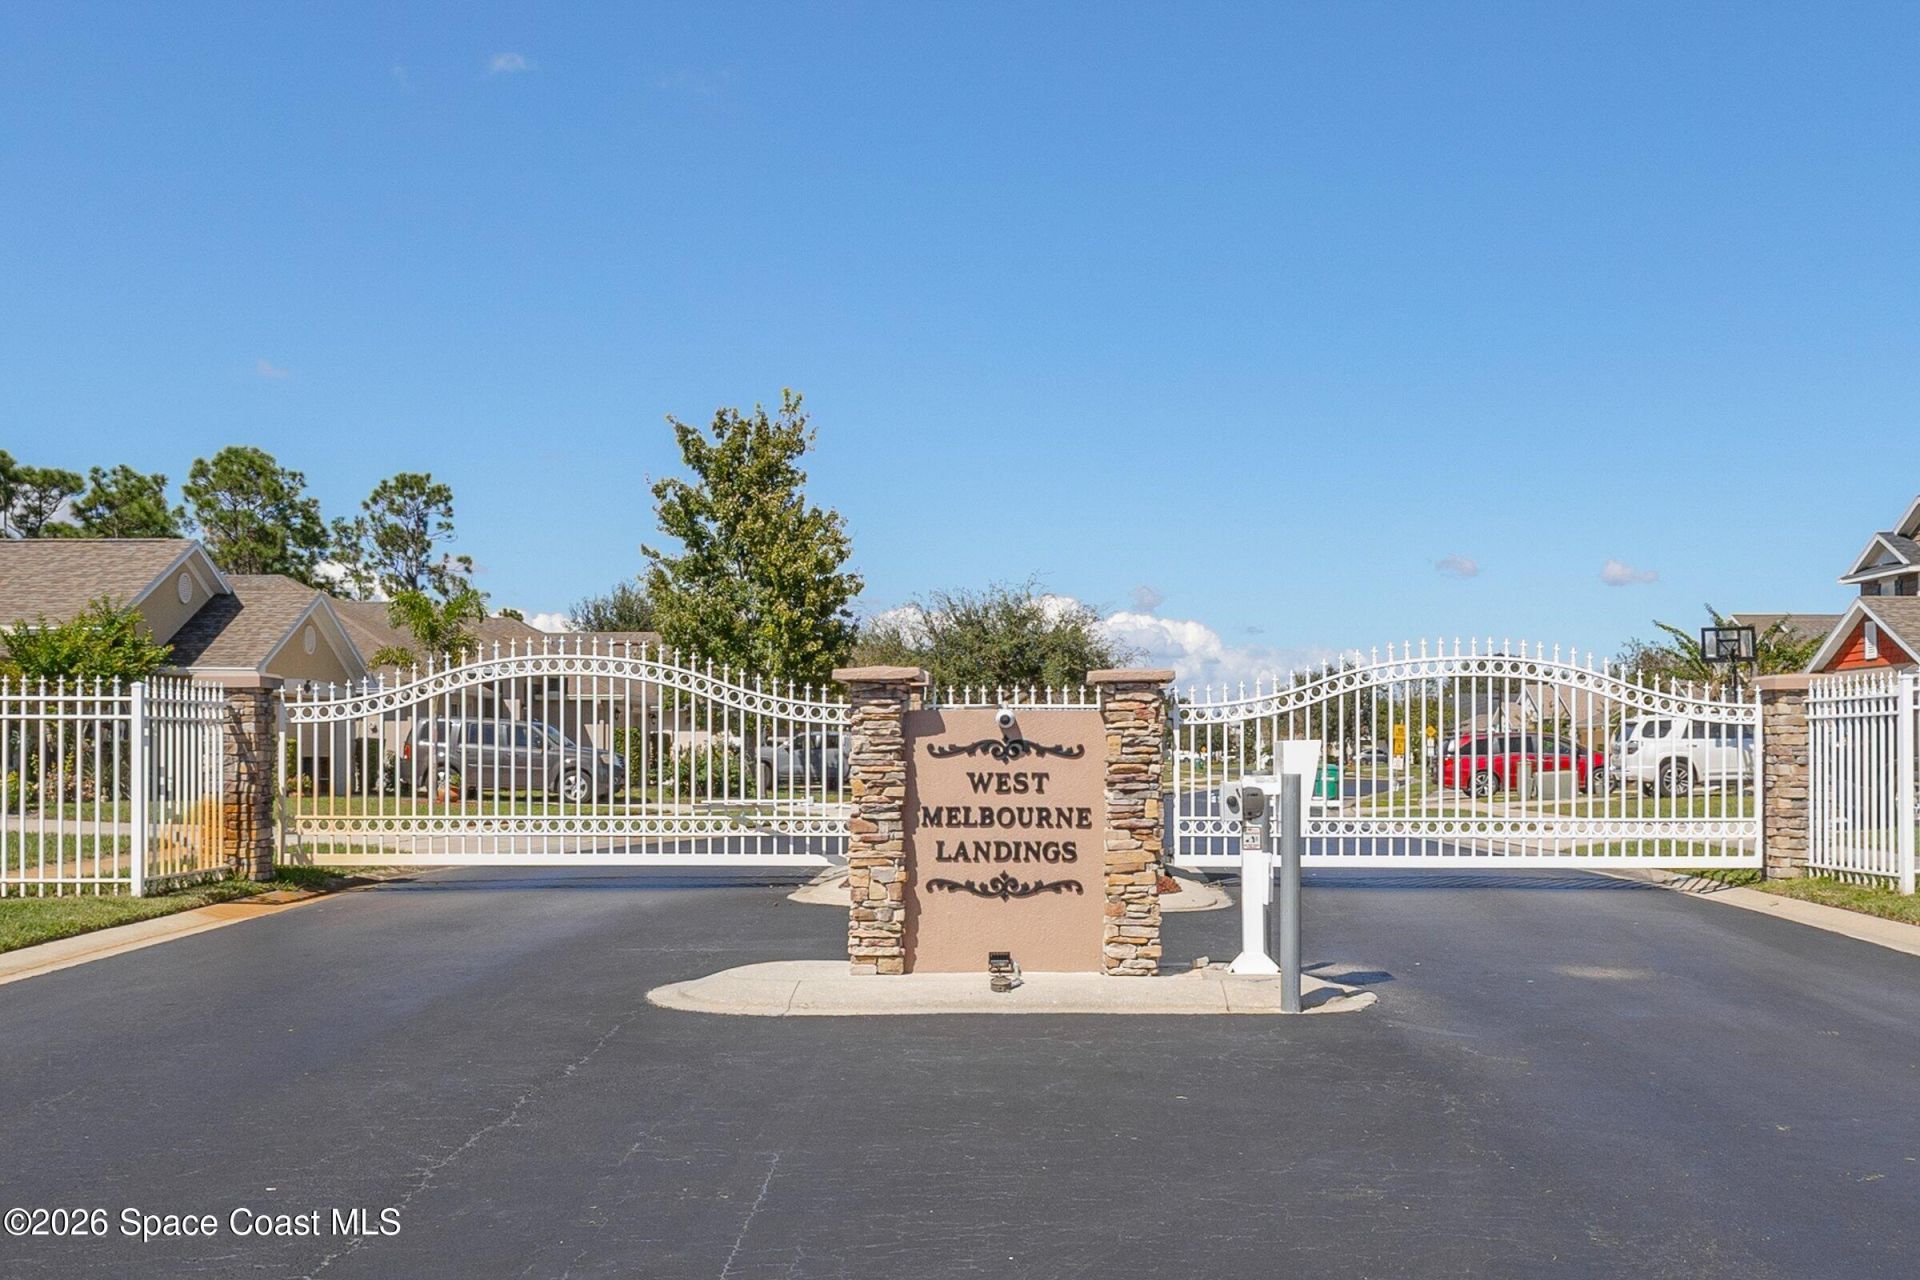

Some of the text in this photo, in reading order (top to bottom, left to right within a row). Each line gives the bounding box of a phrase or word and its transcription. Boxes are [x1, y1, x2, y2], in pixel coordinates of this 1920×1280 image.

[966, 772, 1050, 794] WEST
[921, 806, 1092, 829] MELBOURNE
[936, 840, 1078, 863] LANDINGS
